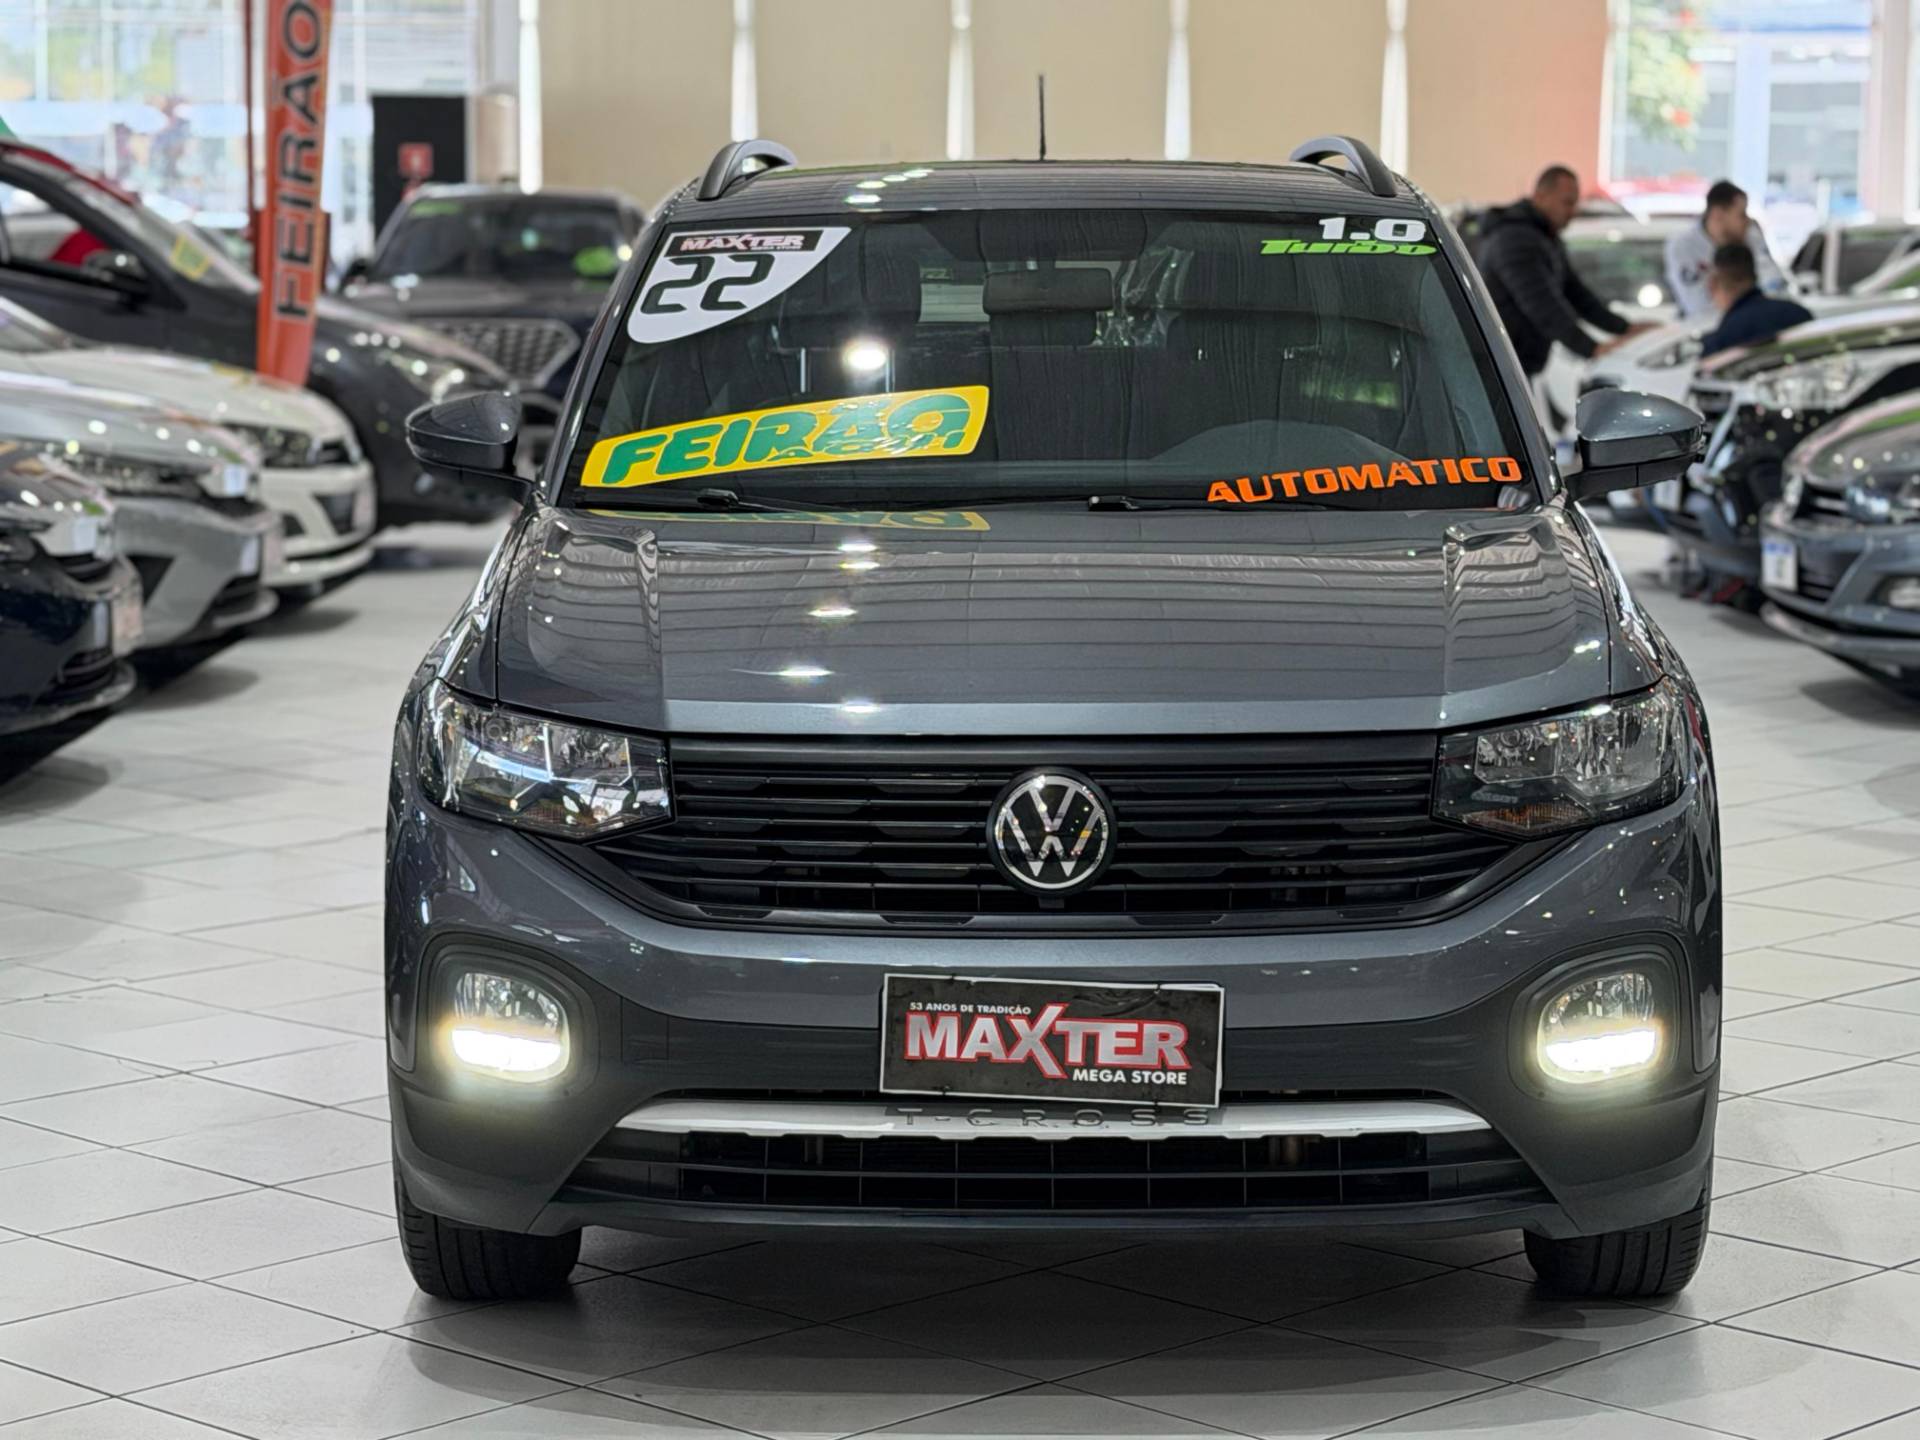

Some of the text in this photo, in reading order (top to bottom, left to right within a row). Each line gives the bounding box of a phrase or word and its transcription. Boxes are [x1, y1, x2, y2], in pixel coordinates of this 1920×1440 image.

[272, 0, 321, 319] FEIRÃO
[1318, 217, 1427, 242] 1.0
[680, 234, 805, 252] MAXTER
[1260, 240, 1437, 255] Turbo
[641, 253, 775, 315] 22
[601, 394, 972, 485] FEIRÃO
[910, 1002, 923, 1011] 53
[926, 1003, 957, 1012] ANOS
[904, 1002, 1192, 1079] MAXTER
[1072, 1069, 1188, 1086] MEGA STORE
[896, 1107, 1209, 1127] T-CROSS
